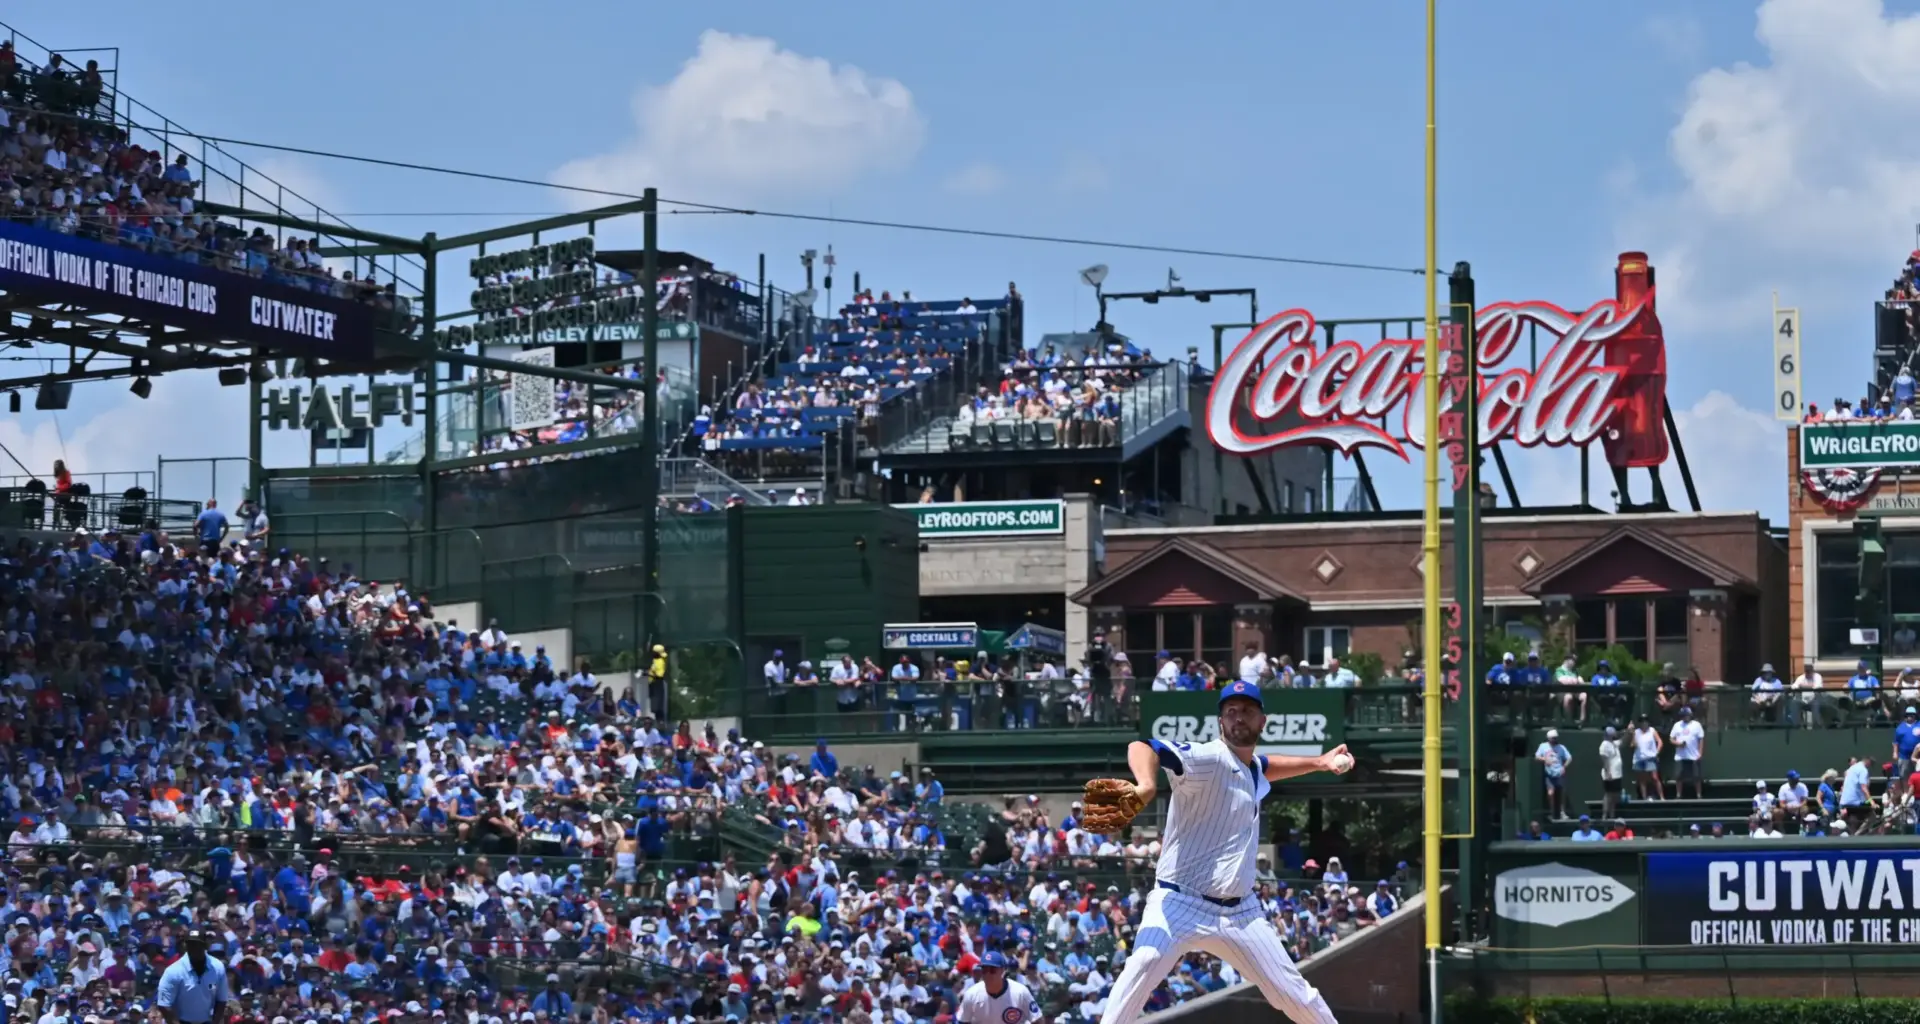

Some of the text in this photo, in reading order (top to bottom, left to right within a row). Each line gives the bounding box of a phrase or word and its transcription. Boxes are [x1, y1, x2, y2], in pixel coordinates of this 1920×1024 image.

[0, 238, 216, 315] OFFICIAL VODKA OF THE CHICAGO CUBS
[251, 295, 336, 341] CUTWATER
[1779, 318, 1795, 411] 460
[268, 384, 414, 430] HALF!
[1439, 324, 1470, 491] Hey Hey
[1810, 433, 1920, 455] WRIGLEYRO
[918, 510, 1054, 528] LEYROOFTOPS.COM
[910, 633, 958, 642] COCKTAILS
[1448, 602, 1462, 703] 355
[1234, 681, 1245, 693] C
[1152, 713, 1328, 742] GRAGER
[1505, 885, 1613, 903] HORNITOS
[1708, 859, 1920, 910] CUTWAT
[1691, 920, 1765, 944] OFFICIAL
[1772, 920, 1826, 944] VODKA
[1833, 919, 1854, 943] OF
[1861, 919, 1891, 943] THE
